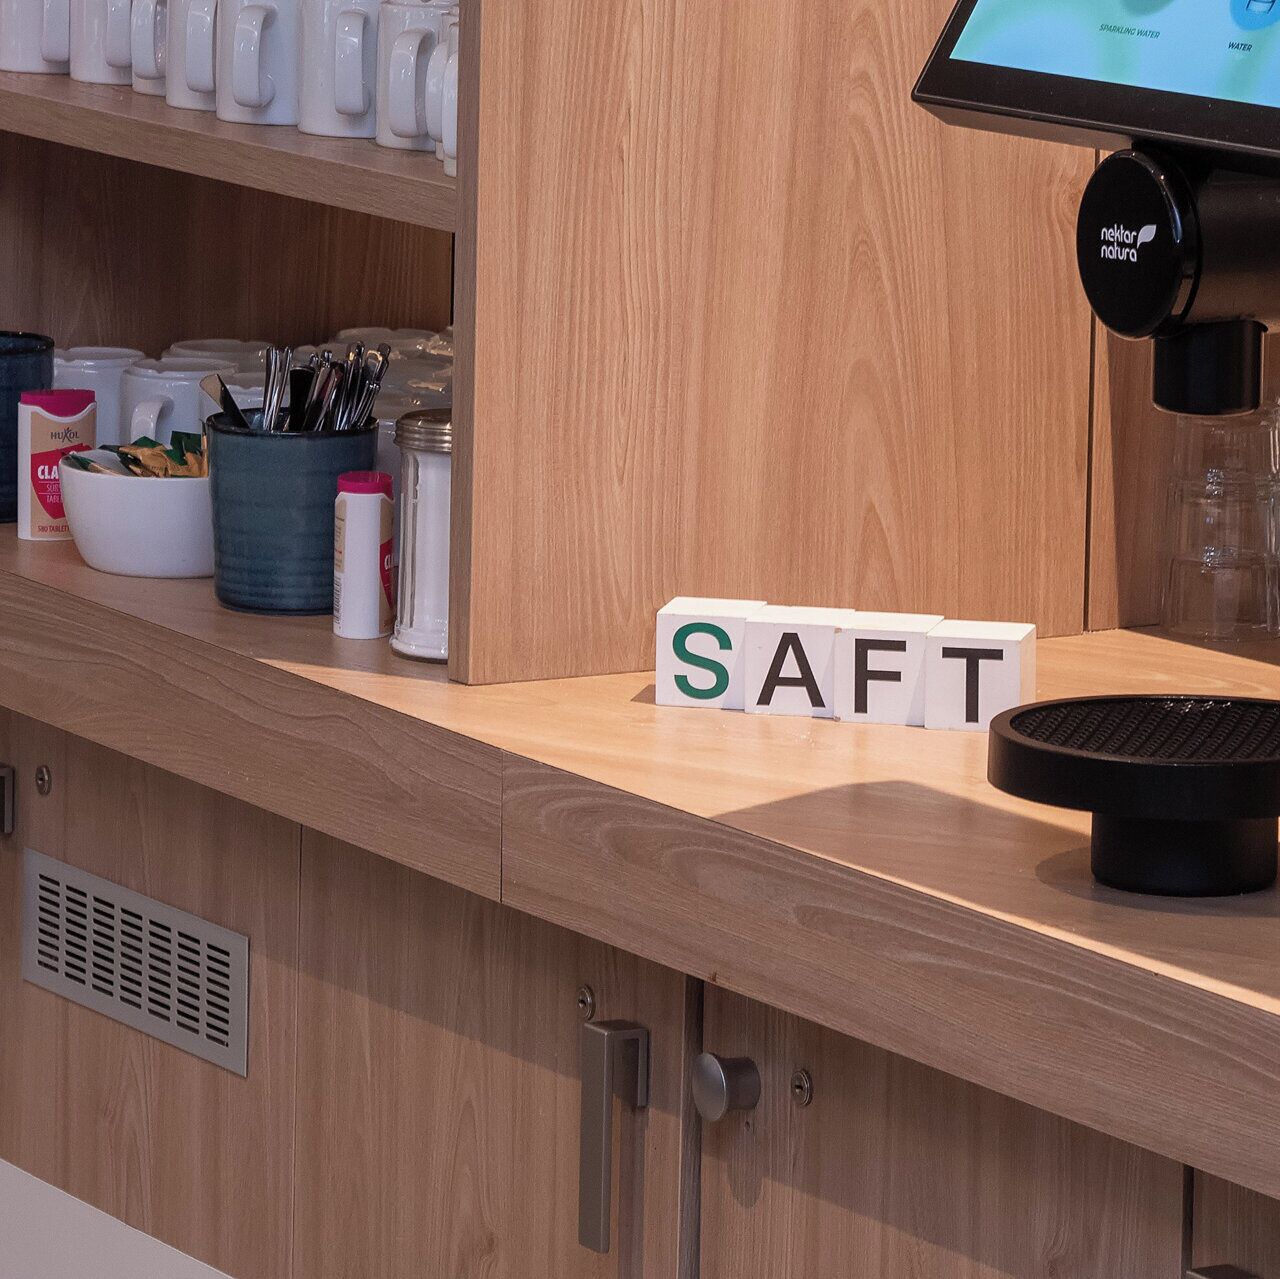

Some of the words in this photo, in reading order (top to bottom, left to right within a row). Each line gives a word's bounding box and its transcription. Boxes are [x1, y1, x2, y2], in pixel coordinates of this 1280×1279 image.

[1099, 24, 1136, 36] SPARKLING
[1136, 28, 1160, 39] WATER
[1228, 41, 1253, 52] WATER
[1101, 223, 1137, 244] nektar
[1101, 242, 1137, 262] natura
[50, 427, 80, 443] HUXOL
[38, 464, 59, 480] CLA
[672, 622, 1004, 723] SAFT
